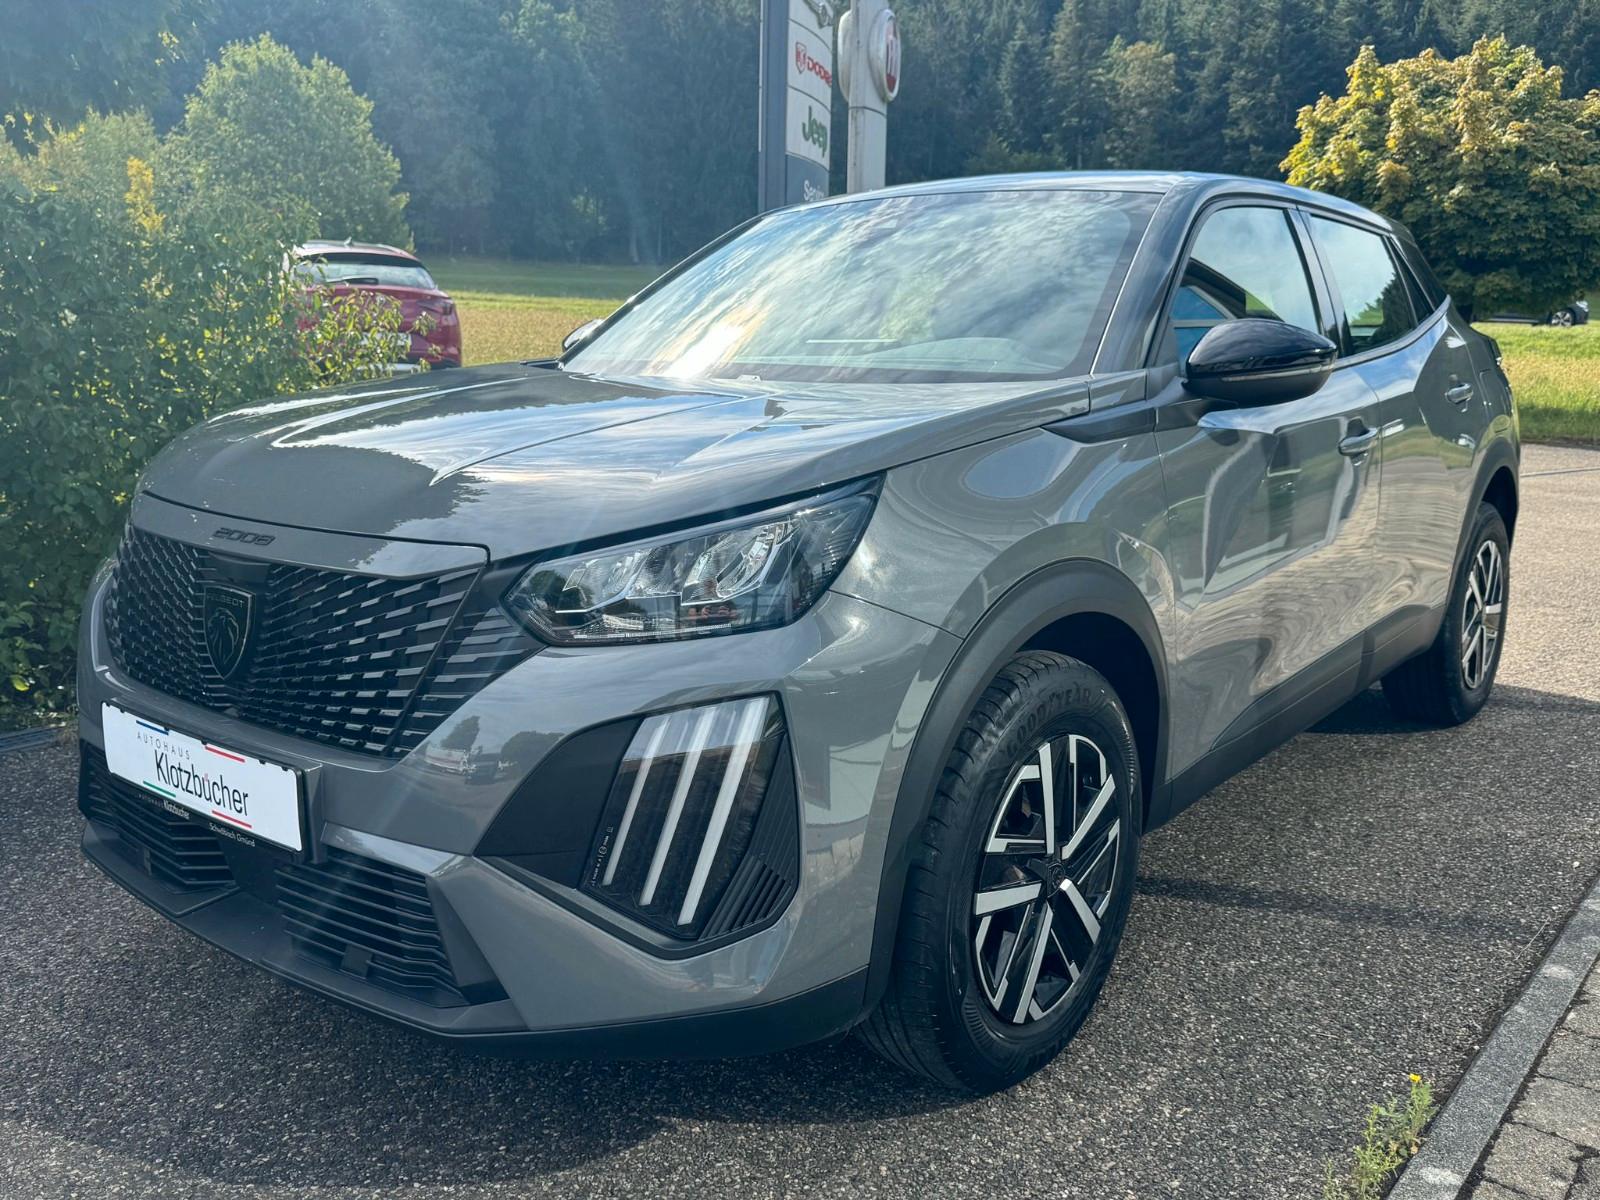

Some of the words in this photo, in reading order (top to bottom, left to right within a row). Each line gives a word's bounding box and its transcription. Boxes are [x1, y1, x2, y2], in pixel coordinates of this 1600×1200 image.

[802, 105, 827, 158] Jeep
[212, 527, 276, 546] 2008
[1006, 683, 1092, 758] GOODYEAR
[136, 731, 191, 760] AUTOHAUS
